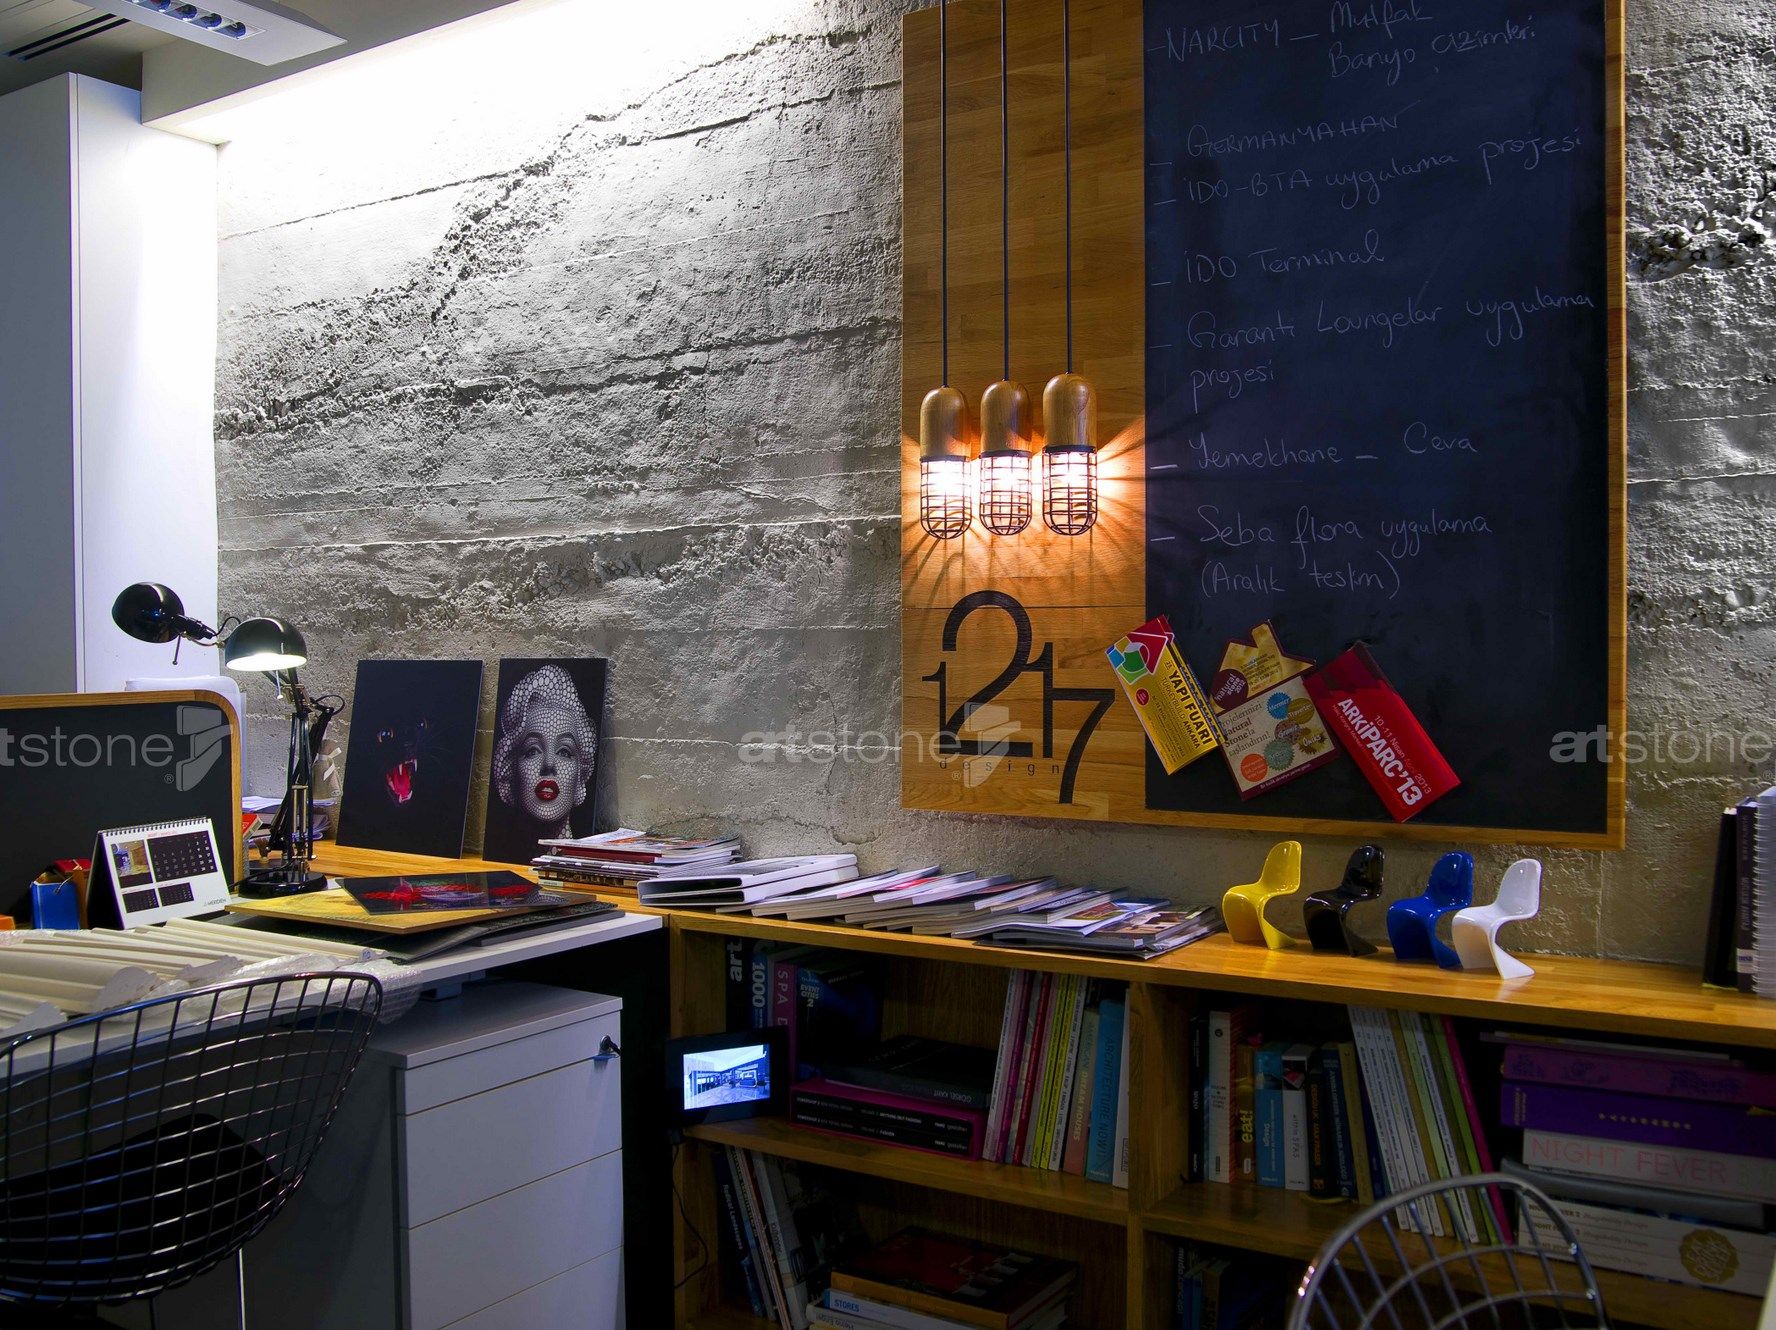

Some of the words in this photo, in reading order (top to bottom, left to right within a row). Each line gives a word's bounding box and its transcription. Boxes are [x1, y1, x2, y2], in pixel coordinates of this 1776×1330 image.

[1165, 20, 1280, 62] NARCITY
[1328, 41, 1416, 87] Banyo
[1248, 228, 1386, 274] Terminal
[1190, 359, 1275, 415] projesi
[1167, 670, 1191, 703] YAPI
[1184, 702, 1213, 745] FUARI
[1214, 672, 1236, 700] natural
[1183, 720, 1201, 749] ANKARA
[726, 941, 743, 983] art
[751, 962, 766, 1008] 1000
[777, 970, 788, 1004] SPA
[1530, 1138, 1624, 1168] NIGHT
[1637, 1151, 1727, 1184] FEVER
[835, 1299, 859, 1312] STORES
